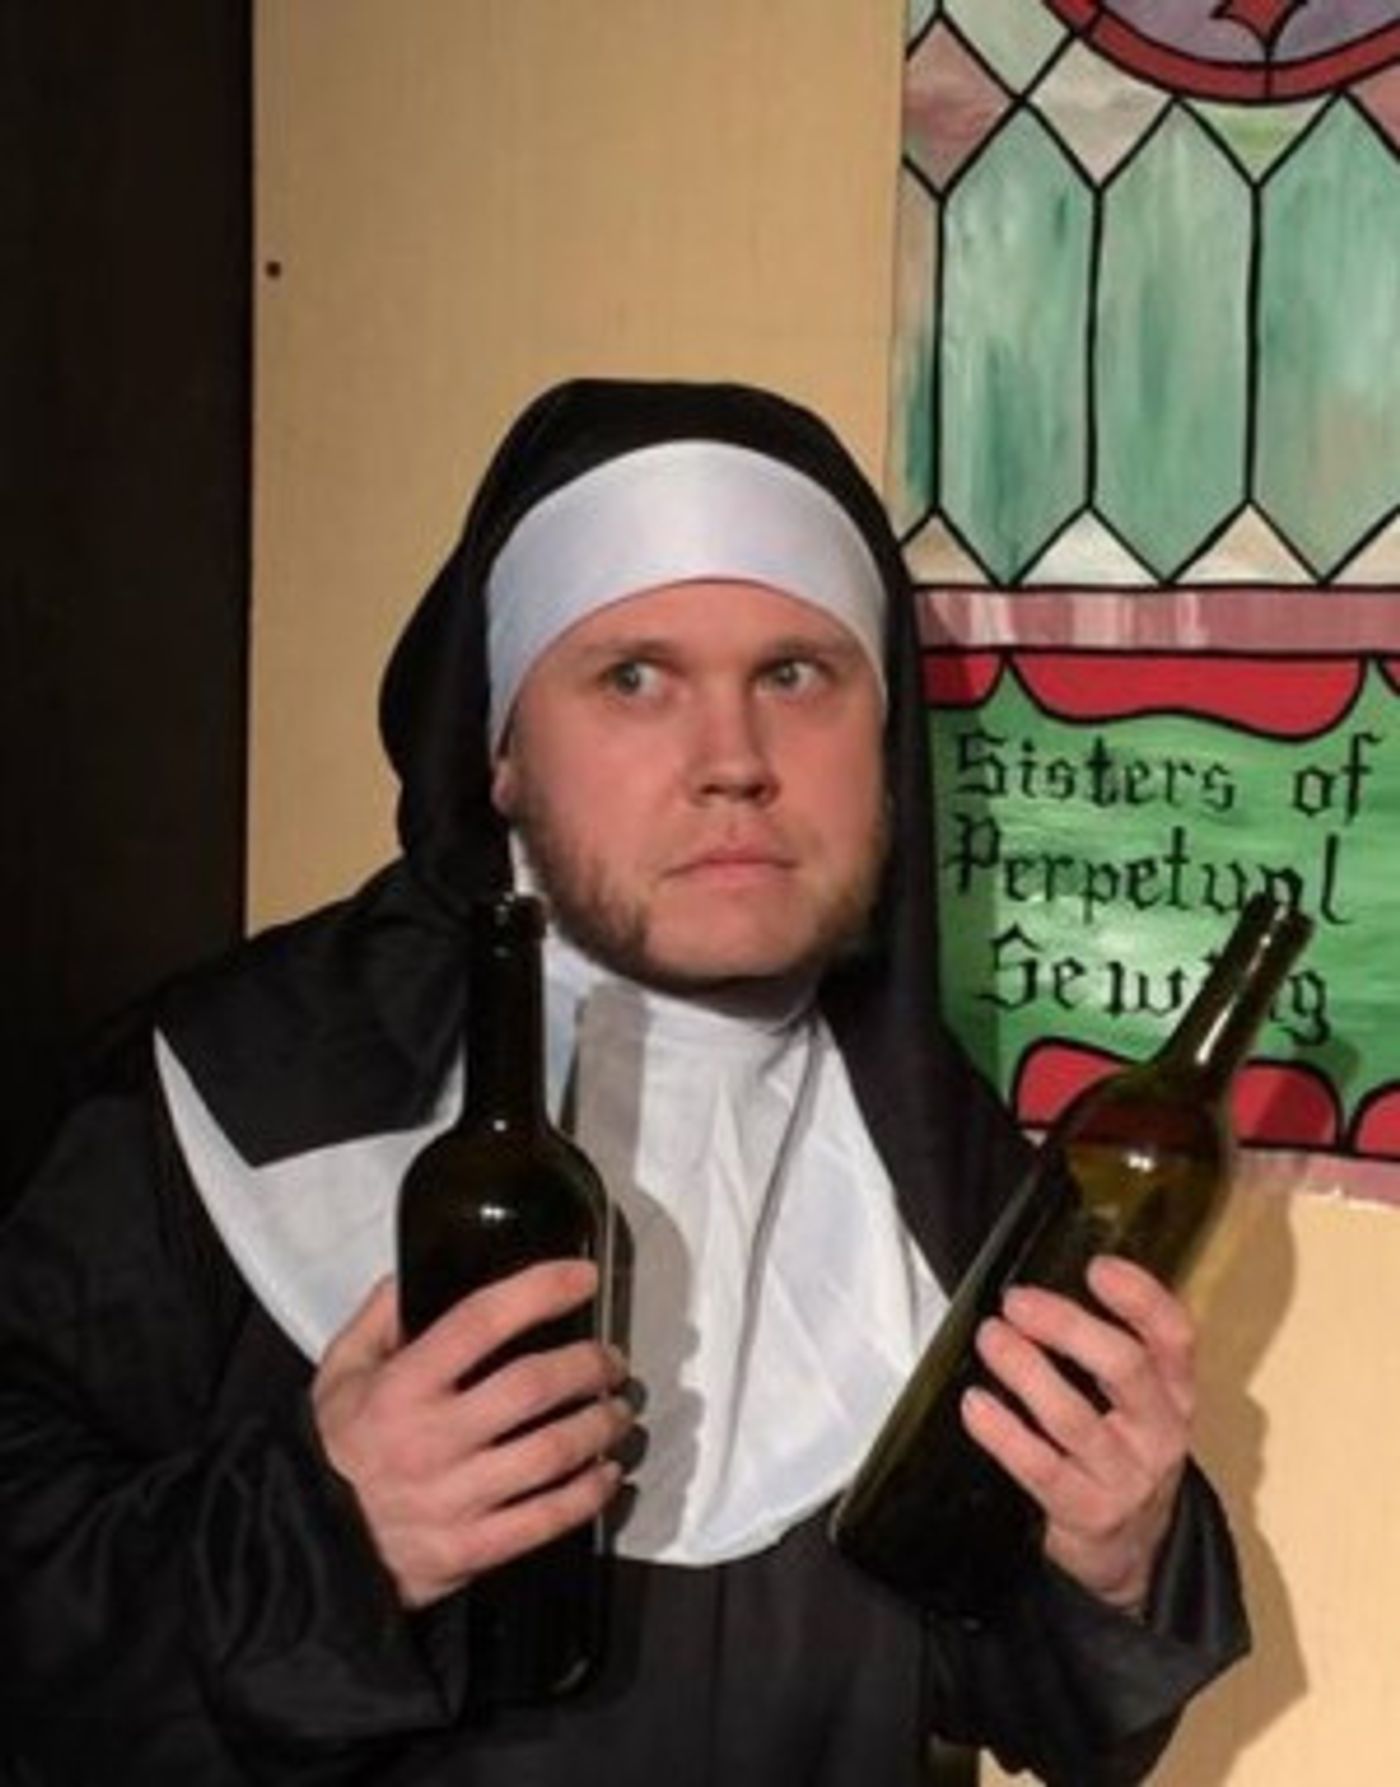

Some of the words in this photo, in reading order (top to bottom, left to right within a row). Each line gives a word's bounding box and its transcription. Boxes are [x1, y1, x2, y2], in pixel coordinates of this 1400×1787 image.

[953, 729, 1235, 812] Sisters
[1292, 732, 1382, 824] of
[976, 922, 1331, 1047] Sewg
